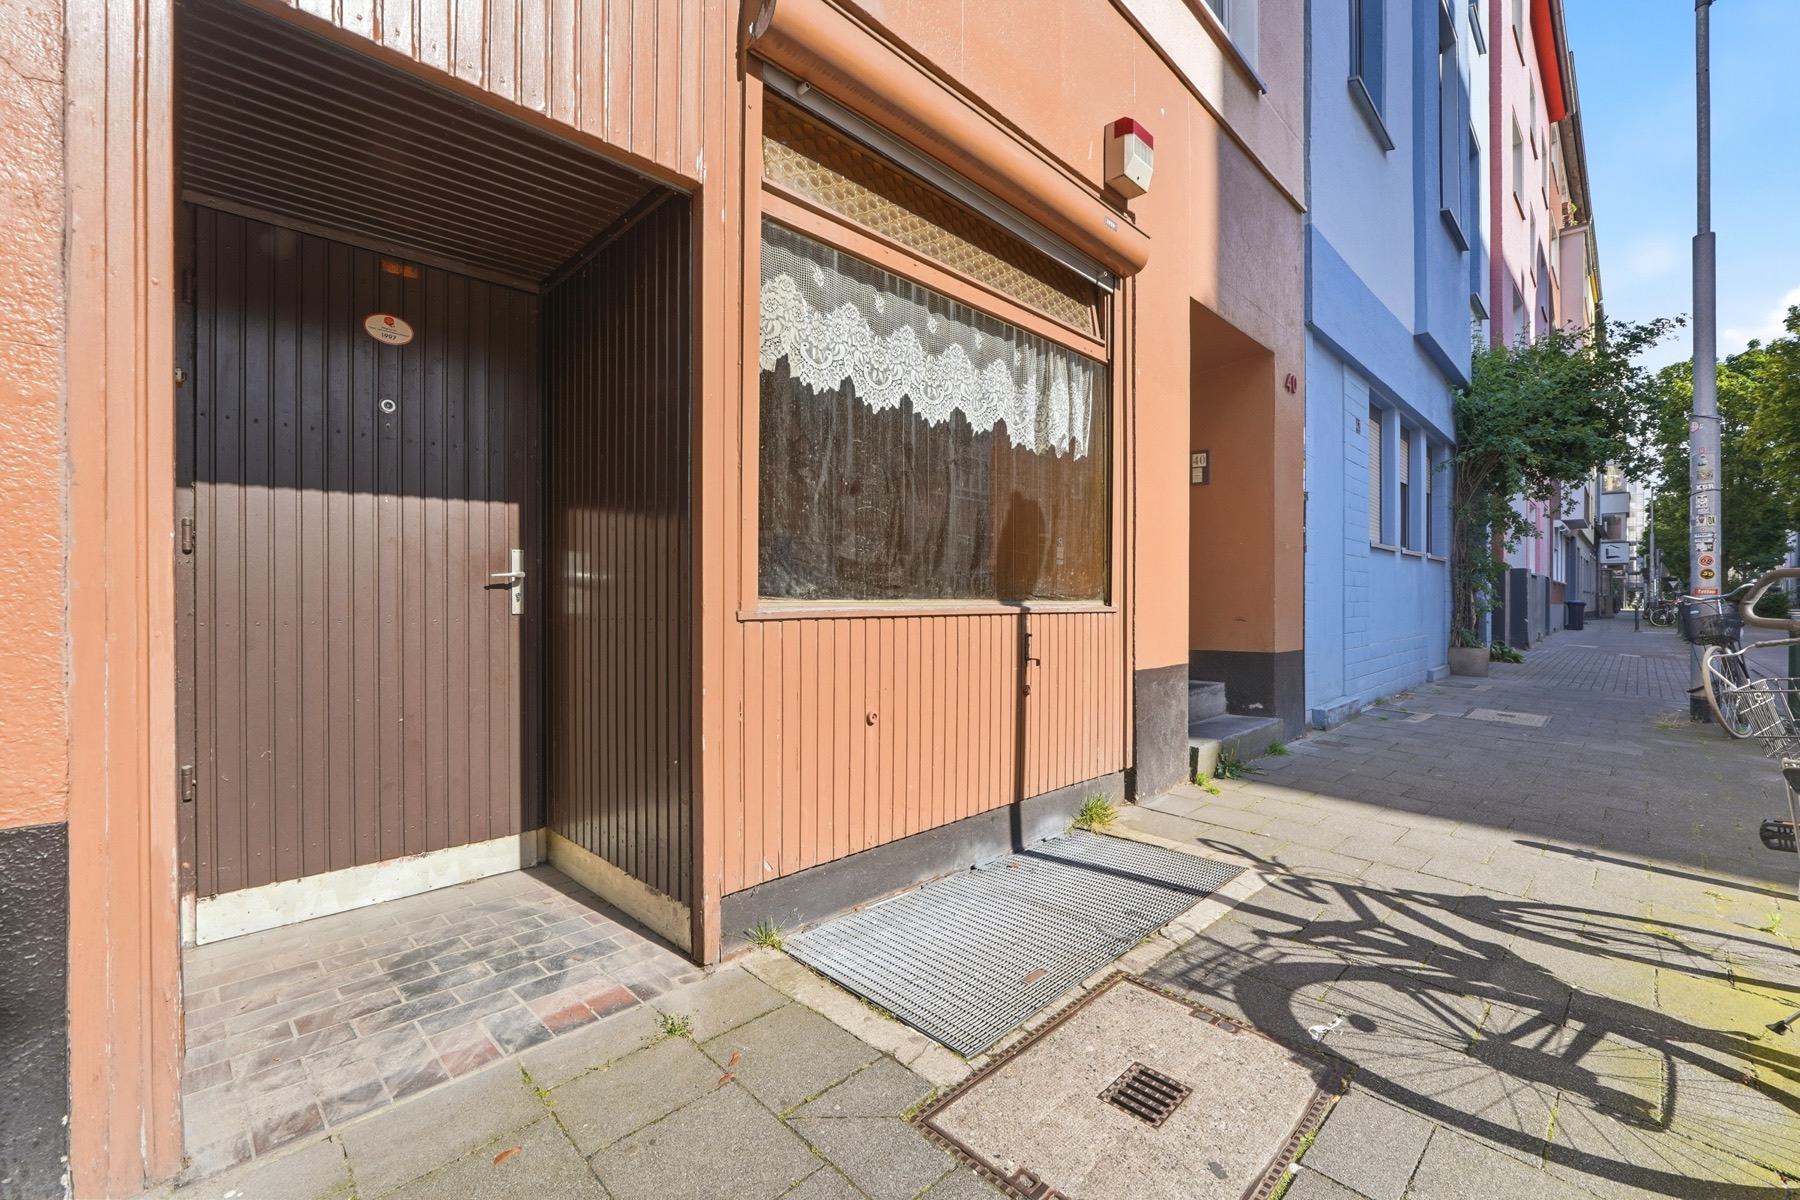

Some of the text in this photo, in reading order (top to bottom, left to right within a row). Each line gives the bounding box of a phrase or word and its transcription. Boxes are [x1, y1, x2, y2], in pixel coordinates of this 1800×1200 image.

[381, 332, 397, 340] 1997
[1285, 373, 1297, 394] 40
[1193, 455, 1205, 465] 40
